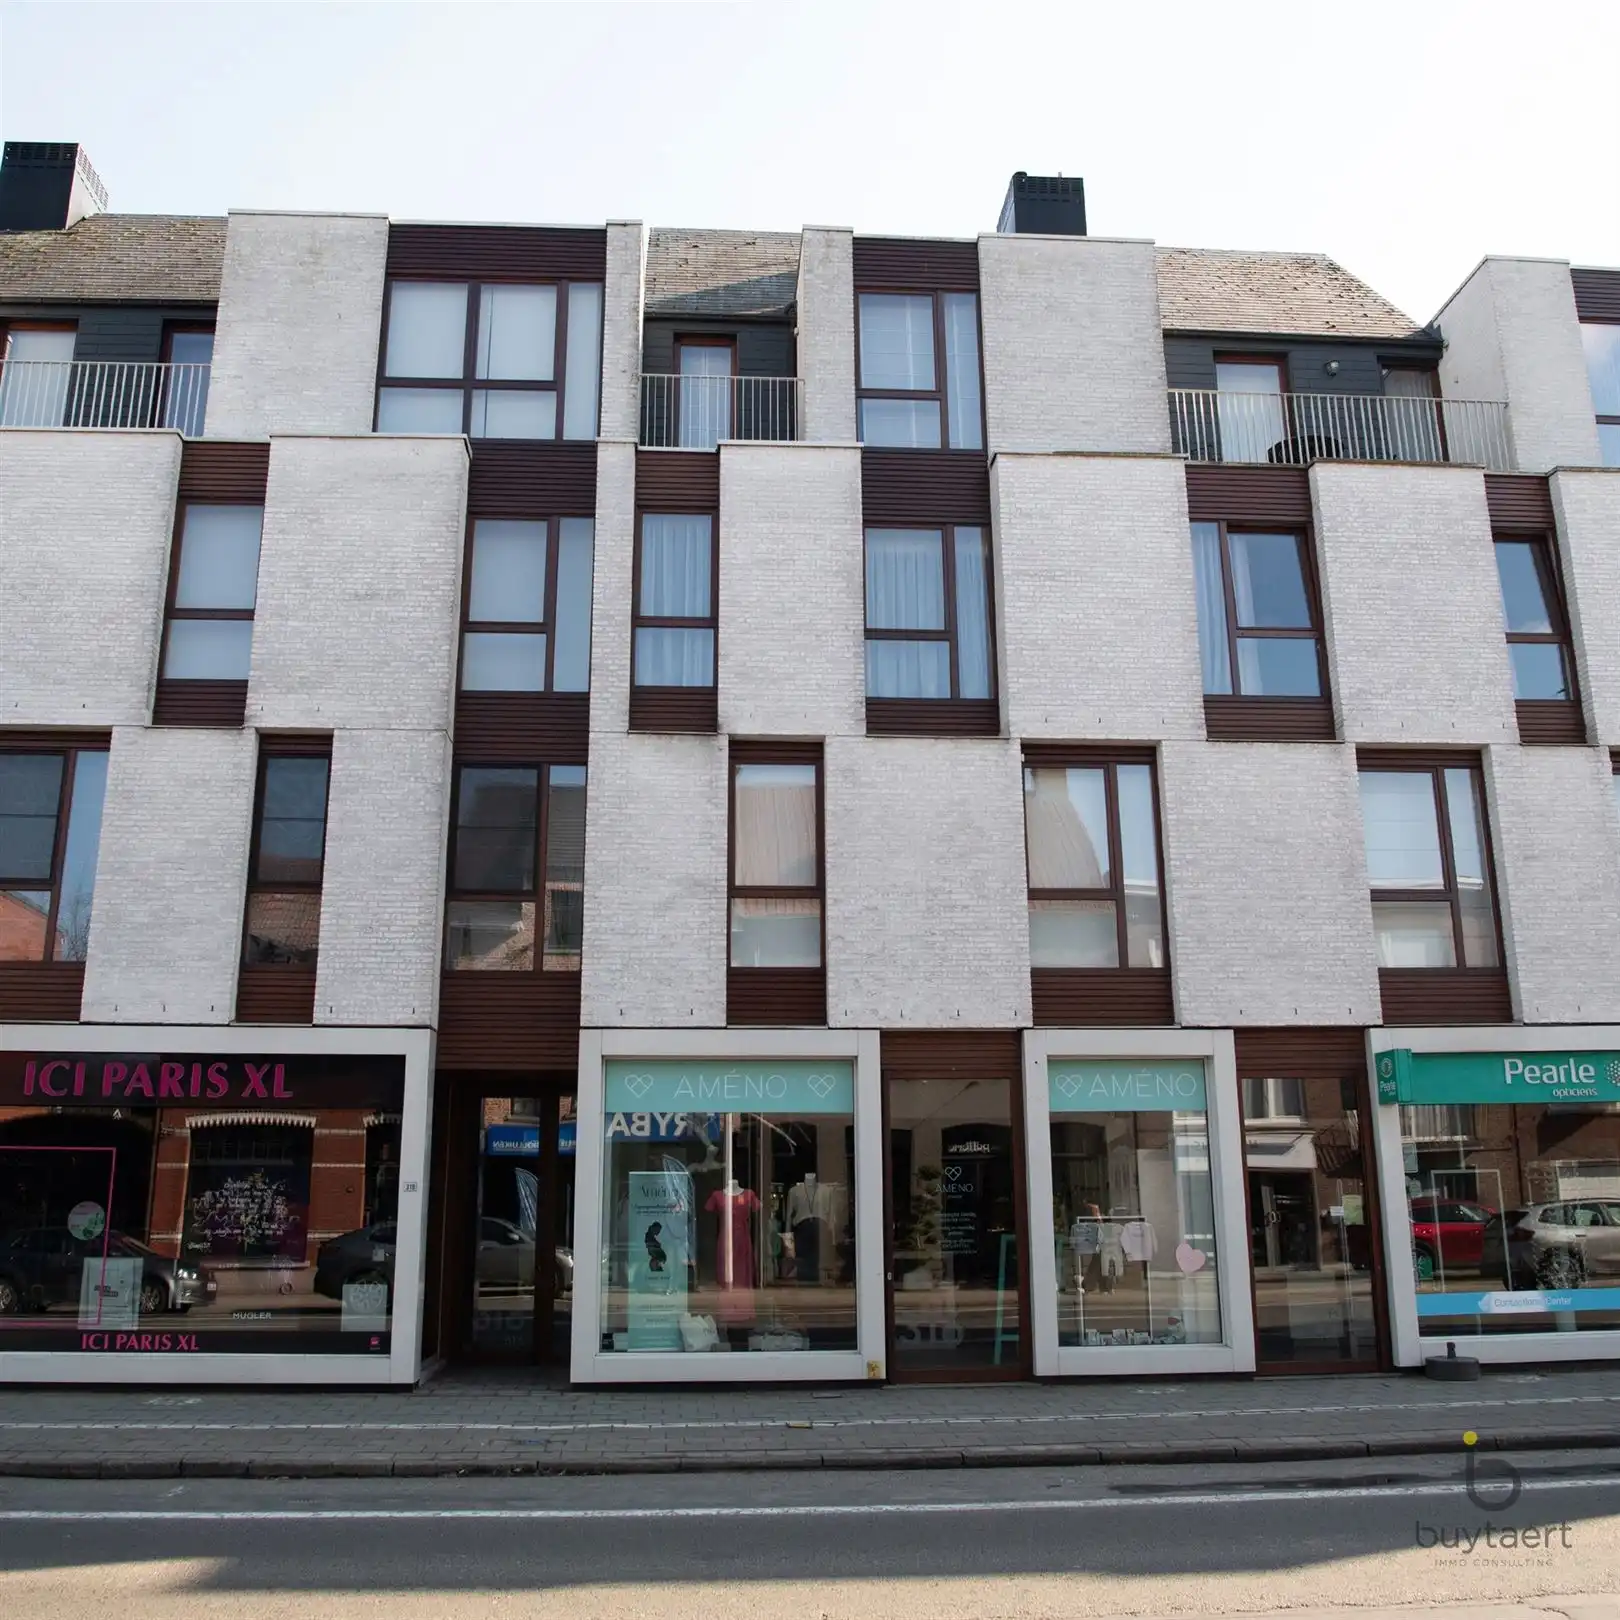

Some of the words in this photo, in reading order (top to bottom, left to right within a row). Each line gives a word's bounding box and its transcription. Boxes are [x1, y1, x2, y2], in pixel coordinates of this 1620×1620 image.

[23, 1060, 86, 1096] ICI
[101, 1062, 230, 1099] PARIS
[241, 1063, 294, 1099] XL
[673, 1069, 788, 1099] AMÉNO
[1088, 1068, 1197, 1098] AMÉNO
[1504, 1058, 1595, 1085] Pearle
[1552, 1087, 1598, 1098] opticiens
[232, 1311, 272, 1320] MUGLER
[81, 1333, 109, 1351] ICI
[115, 1334, 173, 1351] PARIS
[176, 1334, 200, 1352] XL
